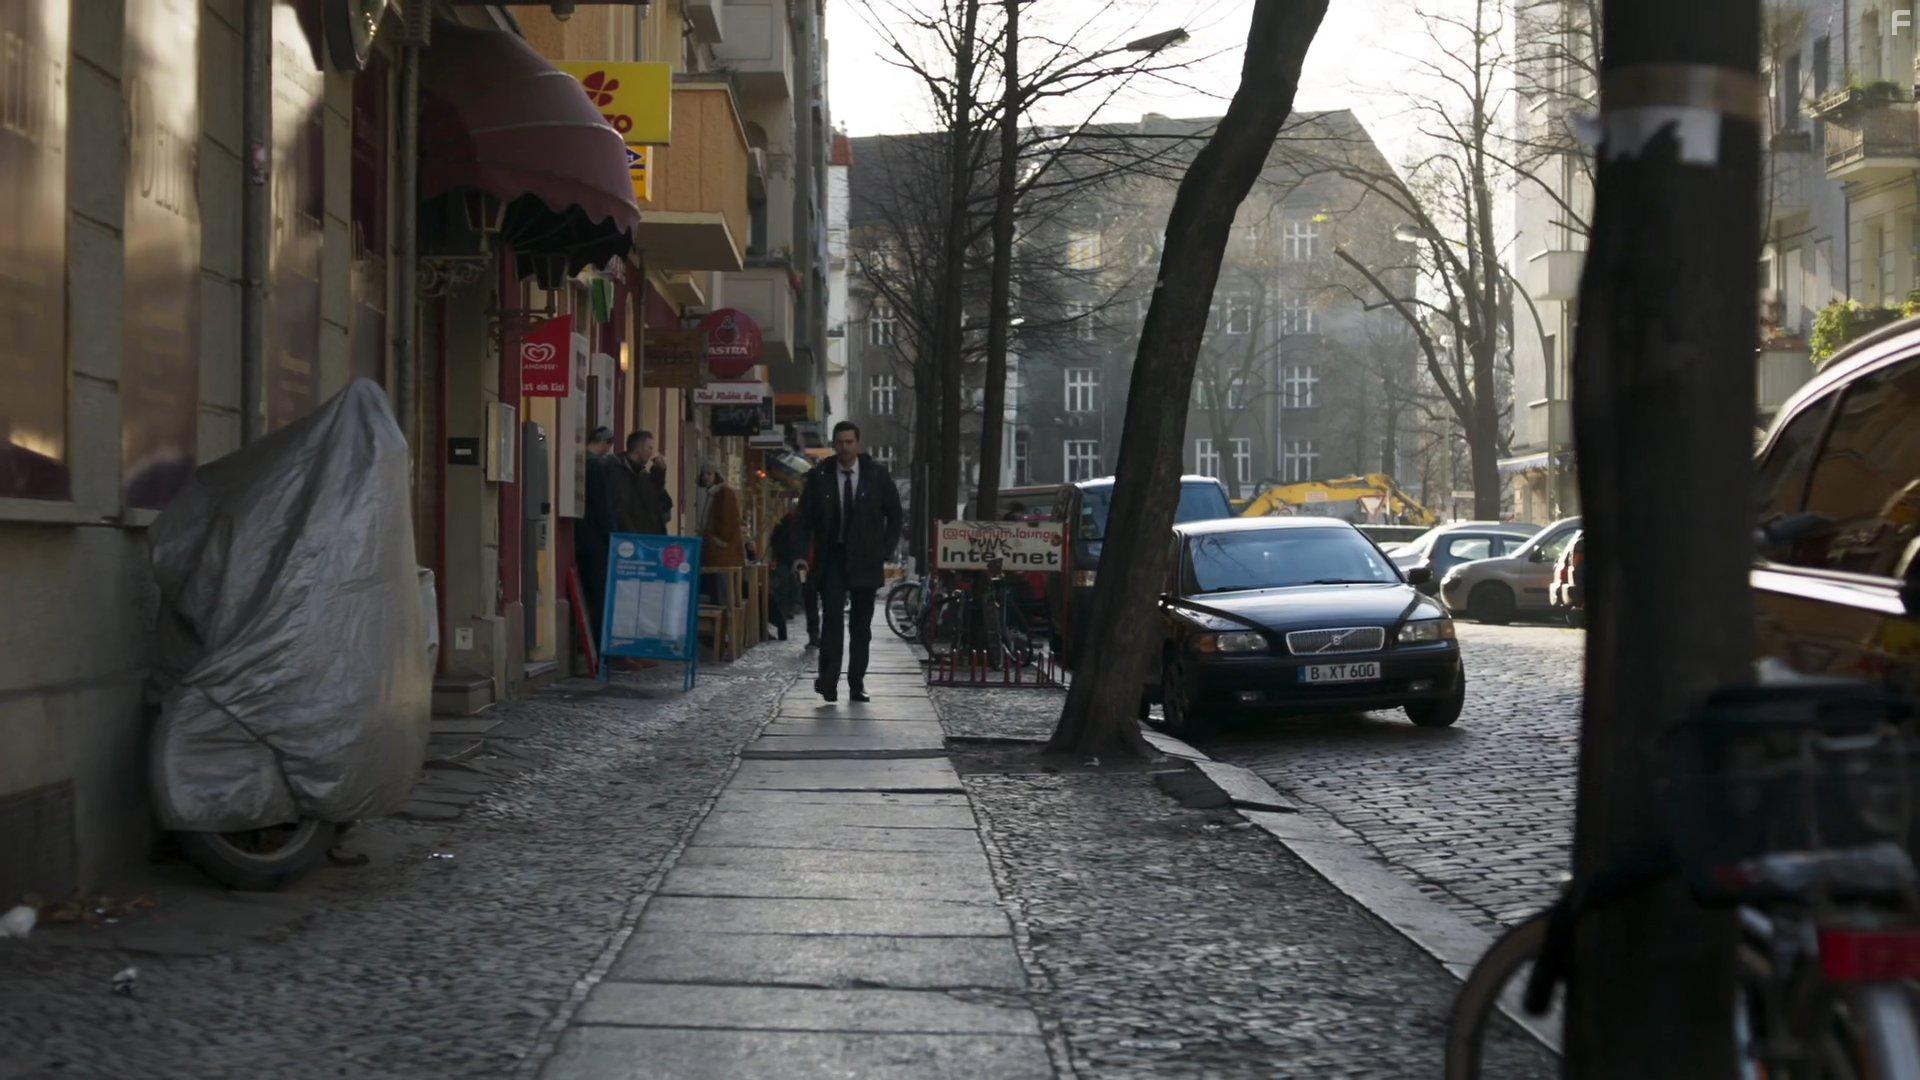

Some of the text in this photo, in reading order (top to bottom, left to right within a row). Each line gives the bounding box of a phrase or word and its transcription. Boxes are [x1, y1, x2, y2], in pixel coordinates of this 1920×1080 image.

[708, 346, 748, 355] ASTRA
[1311, 664, 1375, 680] B XT 600
